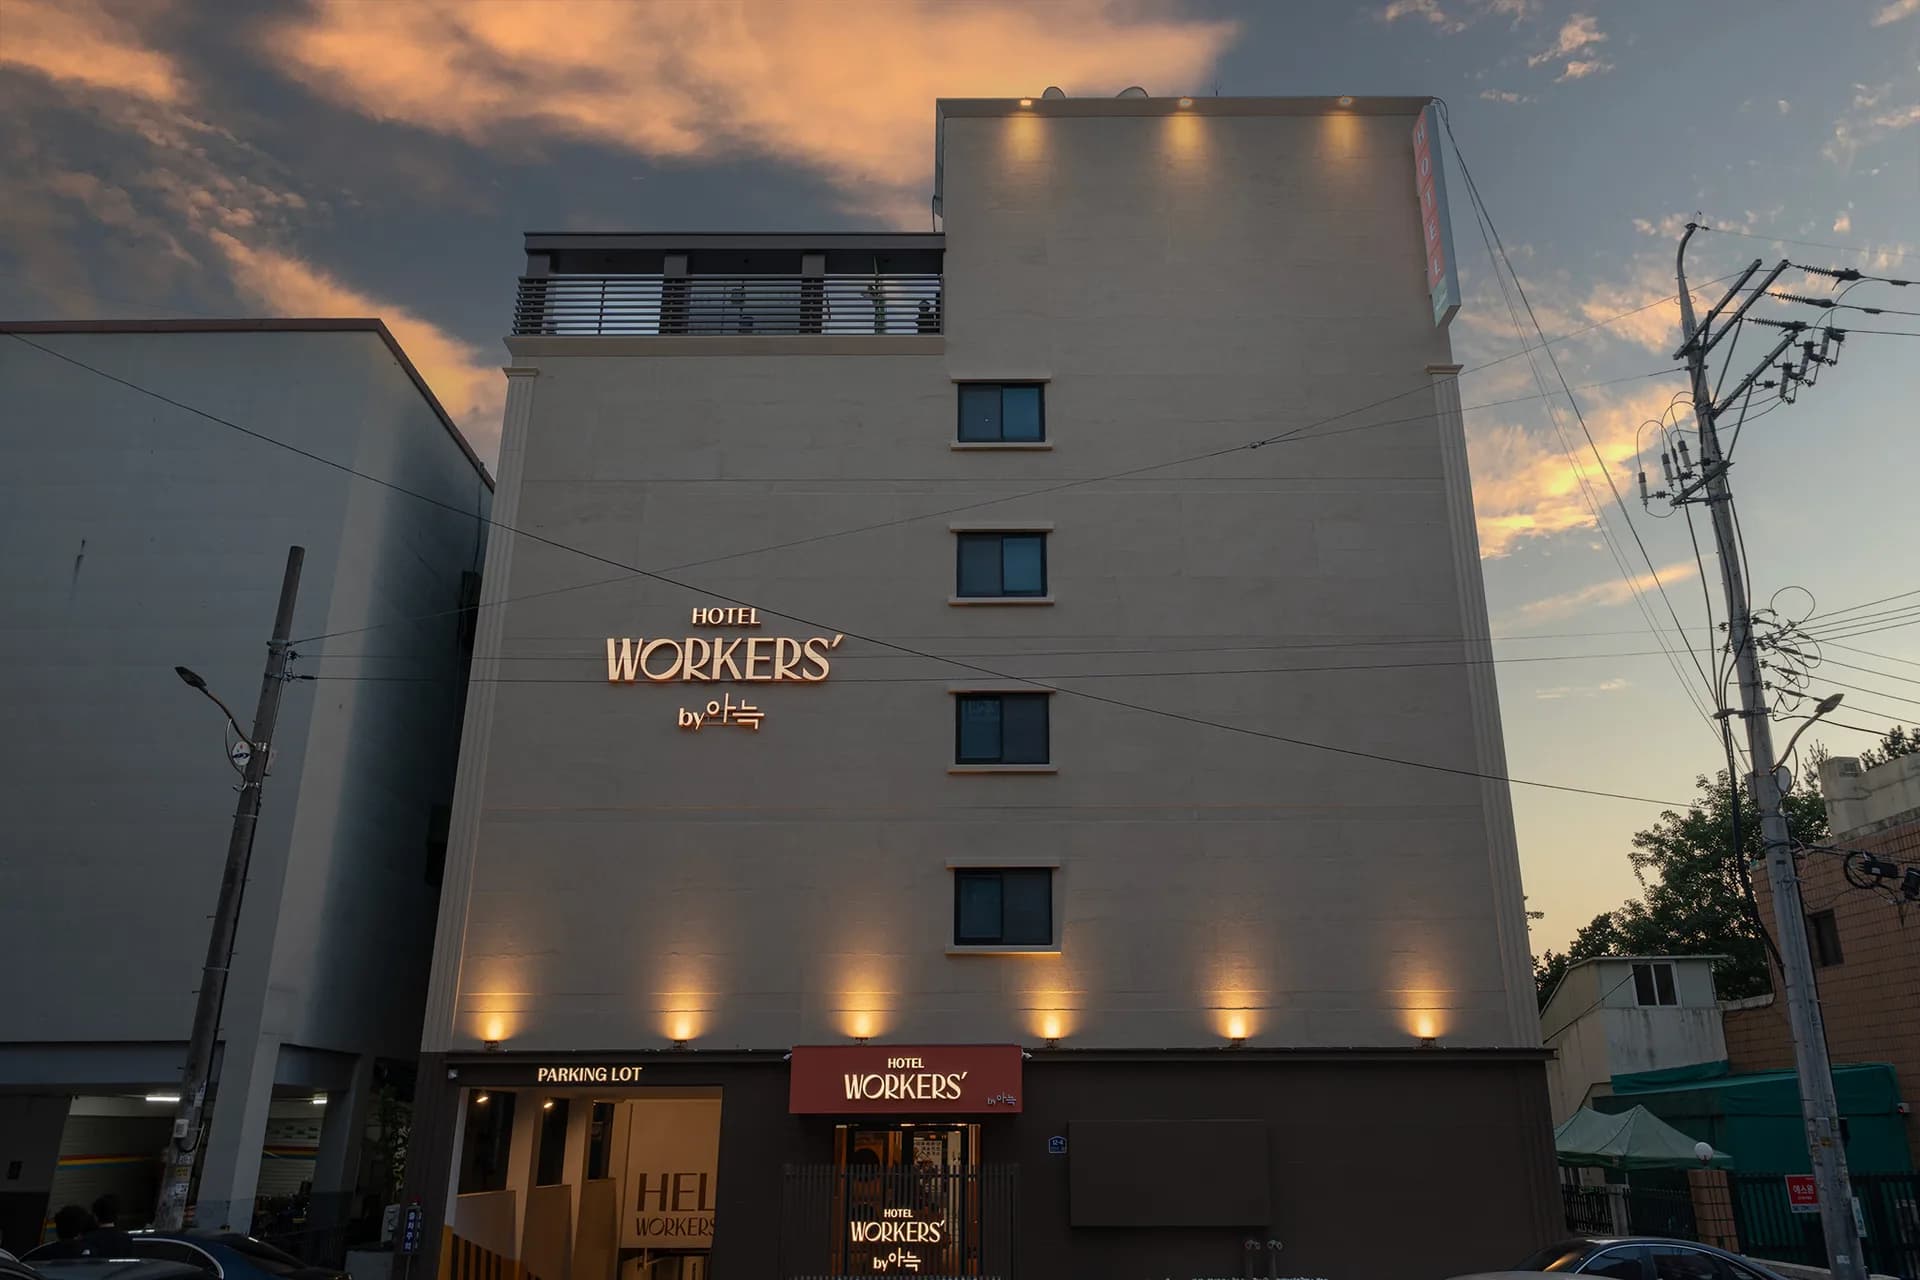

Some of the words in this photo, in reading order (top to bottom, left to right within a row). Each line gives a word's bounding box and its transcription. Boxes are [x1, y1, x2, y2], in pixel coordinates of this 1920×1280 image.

[1416, 124, 1441, 276] HOTEL
[691, 607, 761, 625] HOTEL
[606, 634, 844, 681] WORKERS'
[887, 1057, 925, 1069] HOTEL
[537, 1067, 607, 1082] PARKING
[610, 1066, 643, 1081] LOT
[844, 1071, 968, 1100] WORKERS'
[883, 1209, 913, 1218] HOTEL
[851, 1219, 945, 1242] WORKERS'
